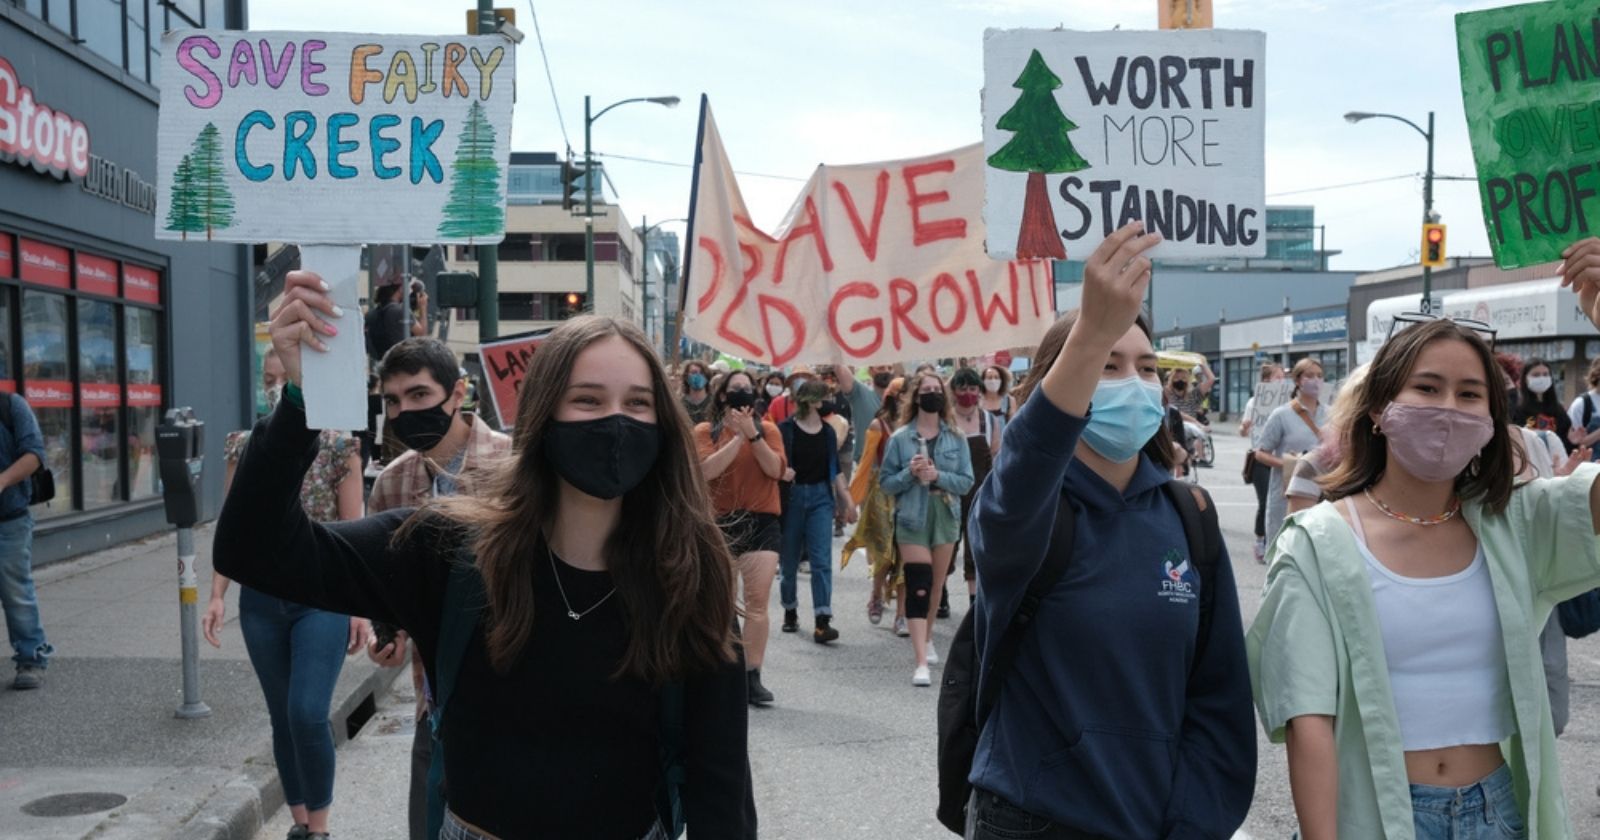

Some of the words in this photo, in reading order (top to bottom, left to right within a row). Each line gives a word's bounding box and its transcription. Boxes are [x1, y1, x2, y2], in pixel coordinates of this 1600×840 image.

[176, 36, 330, 109] SAVE
[350, 42, 504, 104] FAIRY
[1074, 55, 1255, 109] WORTH
[1486, 14, 1600, 93] PLAN
[235, 110, 445, 185] CREEK
[1103, 115, 1223, 167] MORE
[1059, 176, 1259, 247] STANDING
[1486, 160, 1600, 245] PROF
[1162, 580, 1191, 593] FHBC
